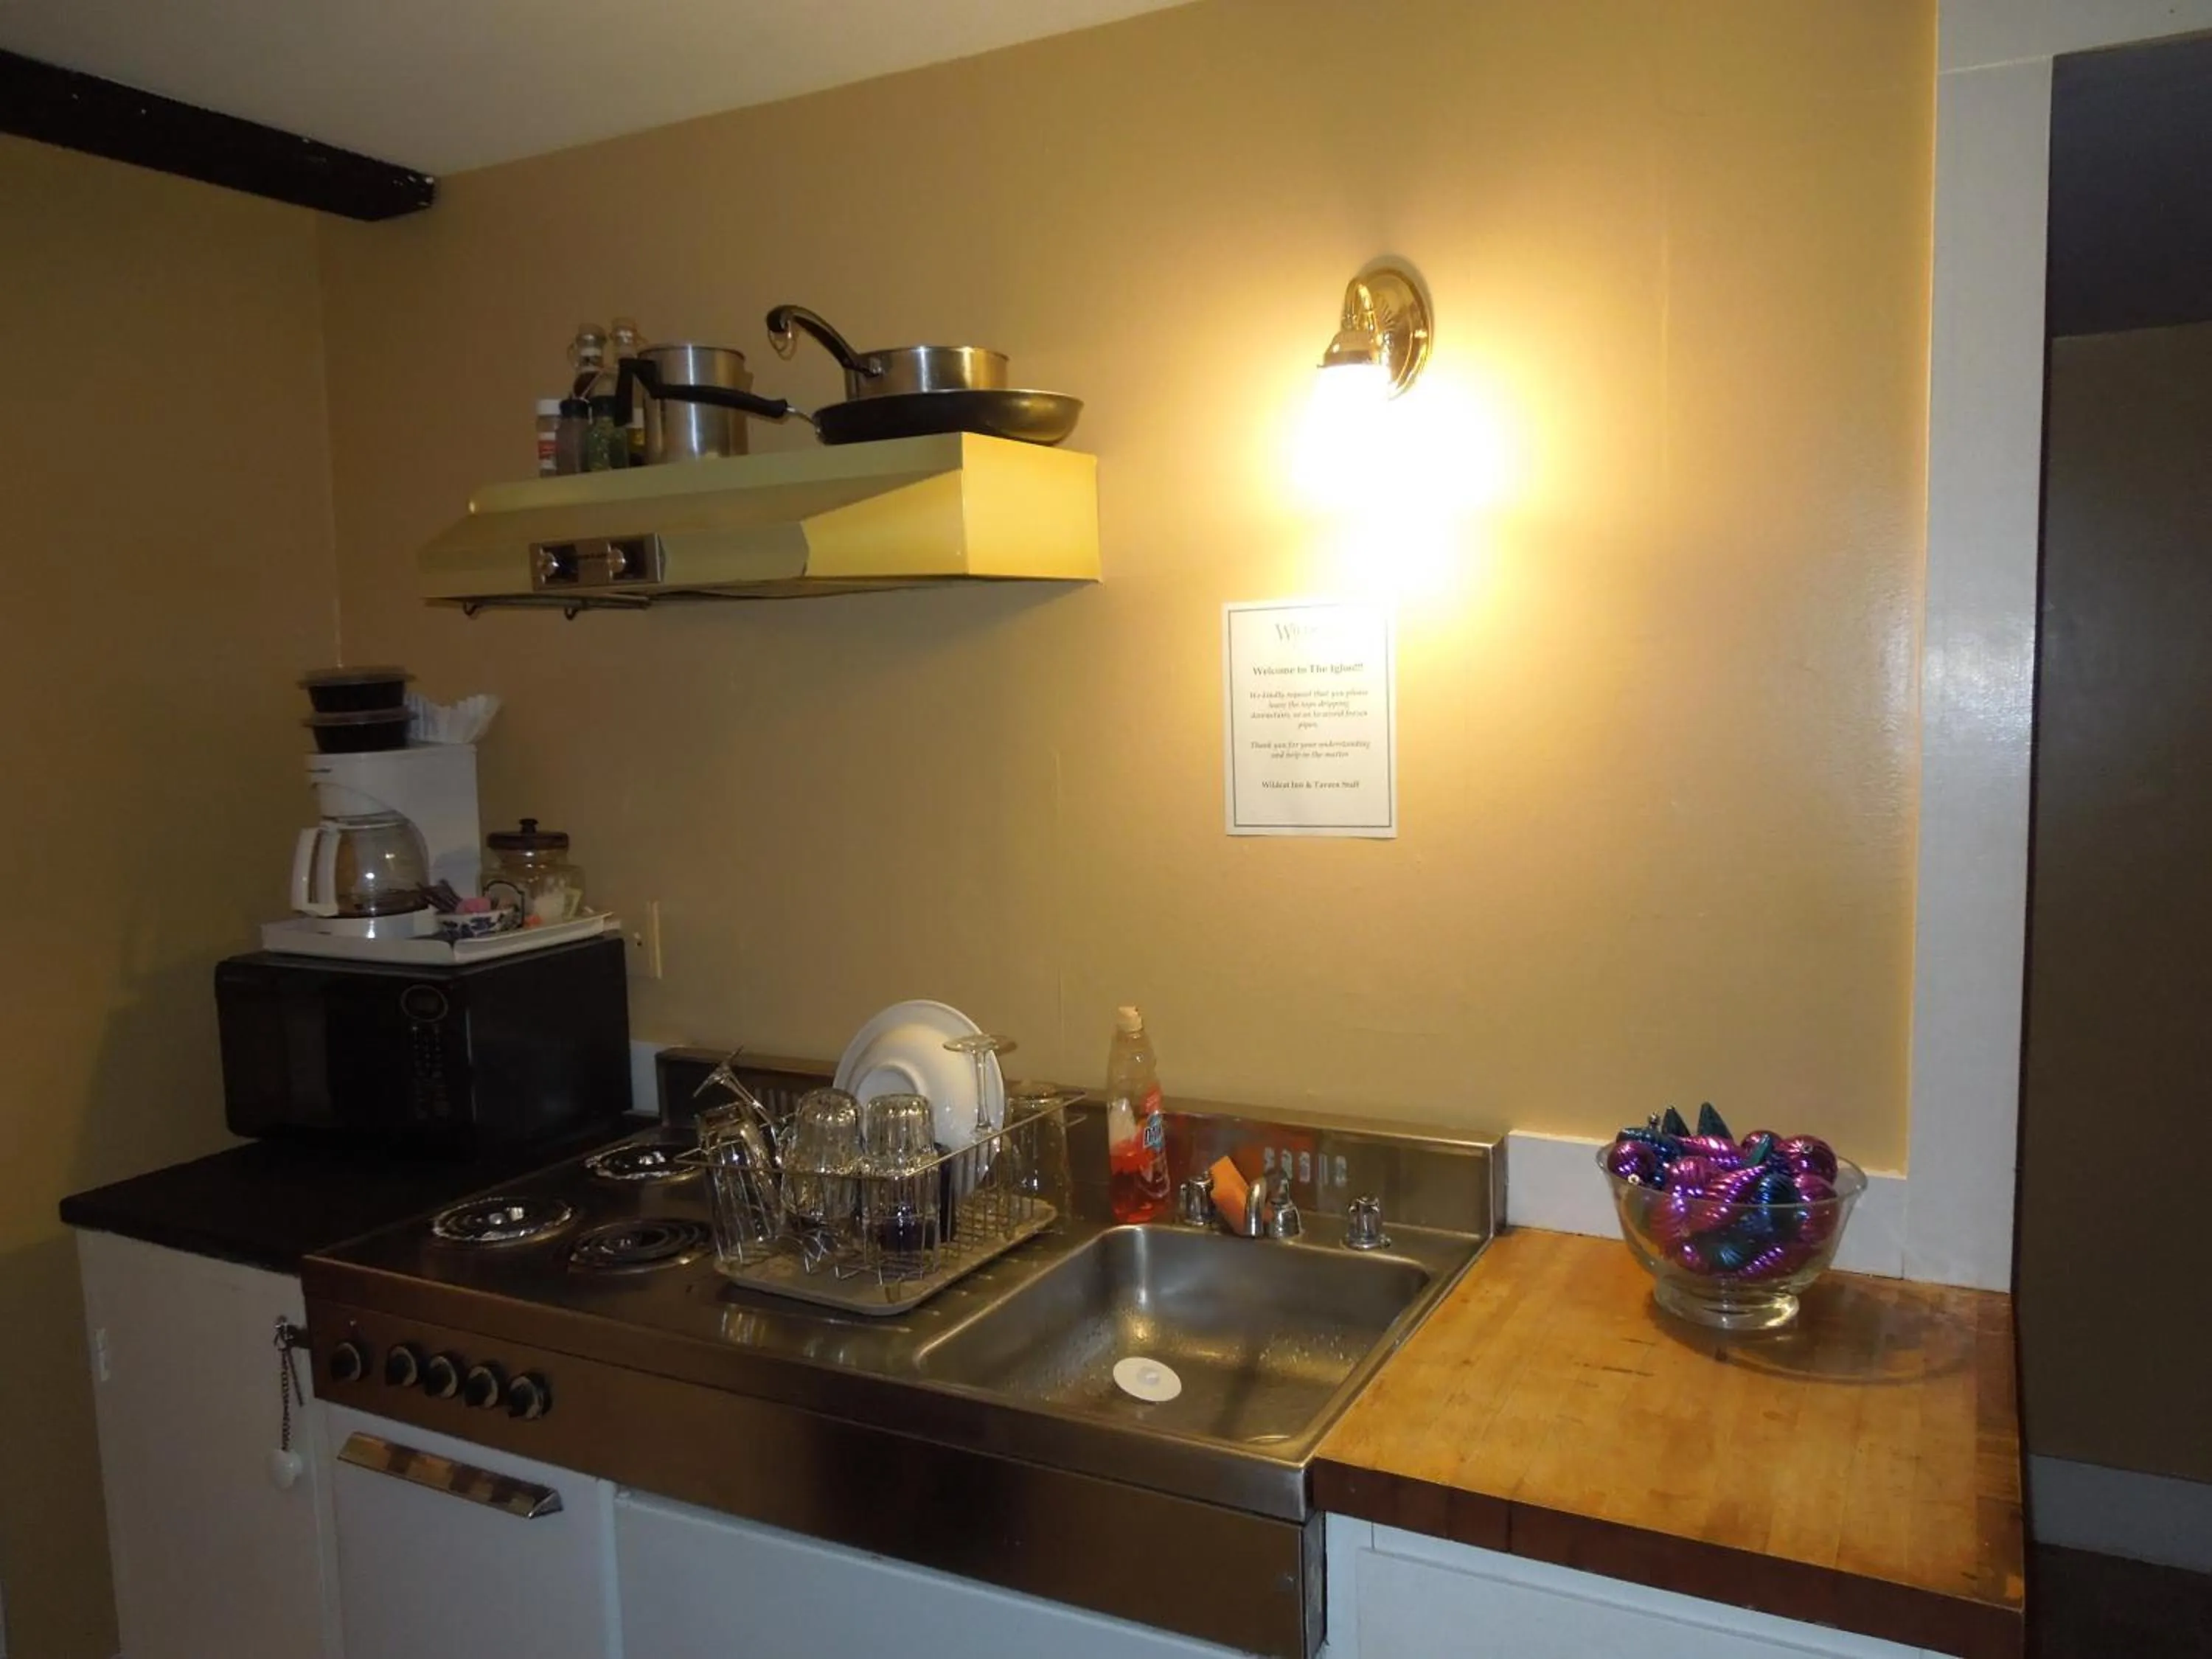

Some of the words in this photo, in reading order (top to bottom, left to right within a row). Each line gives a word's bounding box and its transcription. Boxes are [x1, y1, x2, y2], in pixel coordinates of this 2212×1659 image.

[1252, 665, 1295, 676] Welcome
[1310, 664, 1328, 673] The
[1262, 780, 1290, 789] Wildcat
[1314, 780, 1340, 789] Tavern
